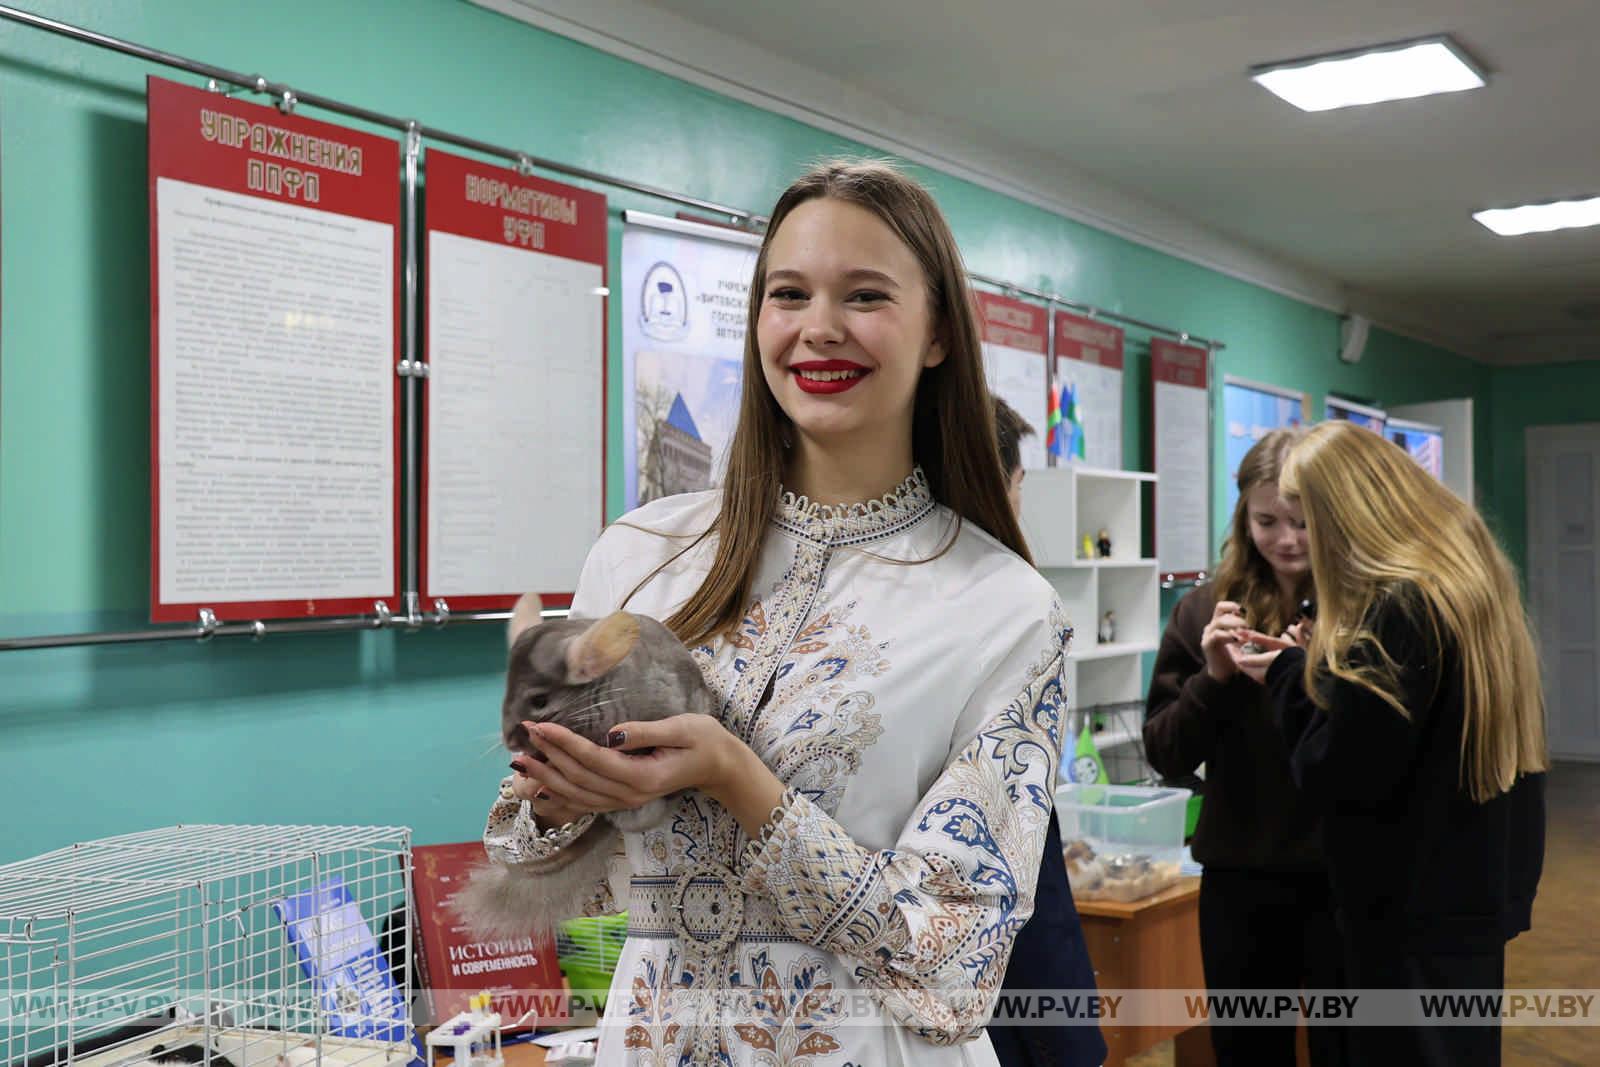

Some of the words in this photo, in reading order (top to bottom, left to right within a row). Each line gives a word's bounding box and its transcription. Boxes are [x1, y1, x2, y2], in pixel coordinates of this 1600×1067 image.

[200, 108, 363, 177] УПРАЖНЕНИЯ
[247, 158, 320, 203] ППФП
[465, 173, 578, 226] НОРМАТИВЫ
[451, 963, 461, 976] И
[462, 954, 538, 975] СОВРЕМЕННОСТЬ
